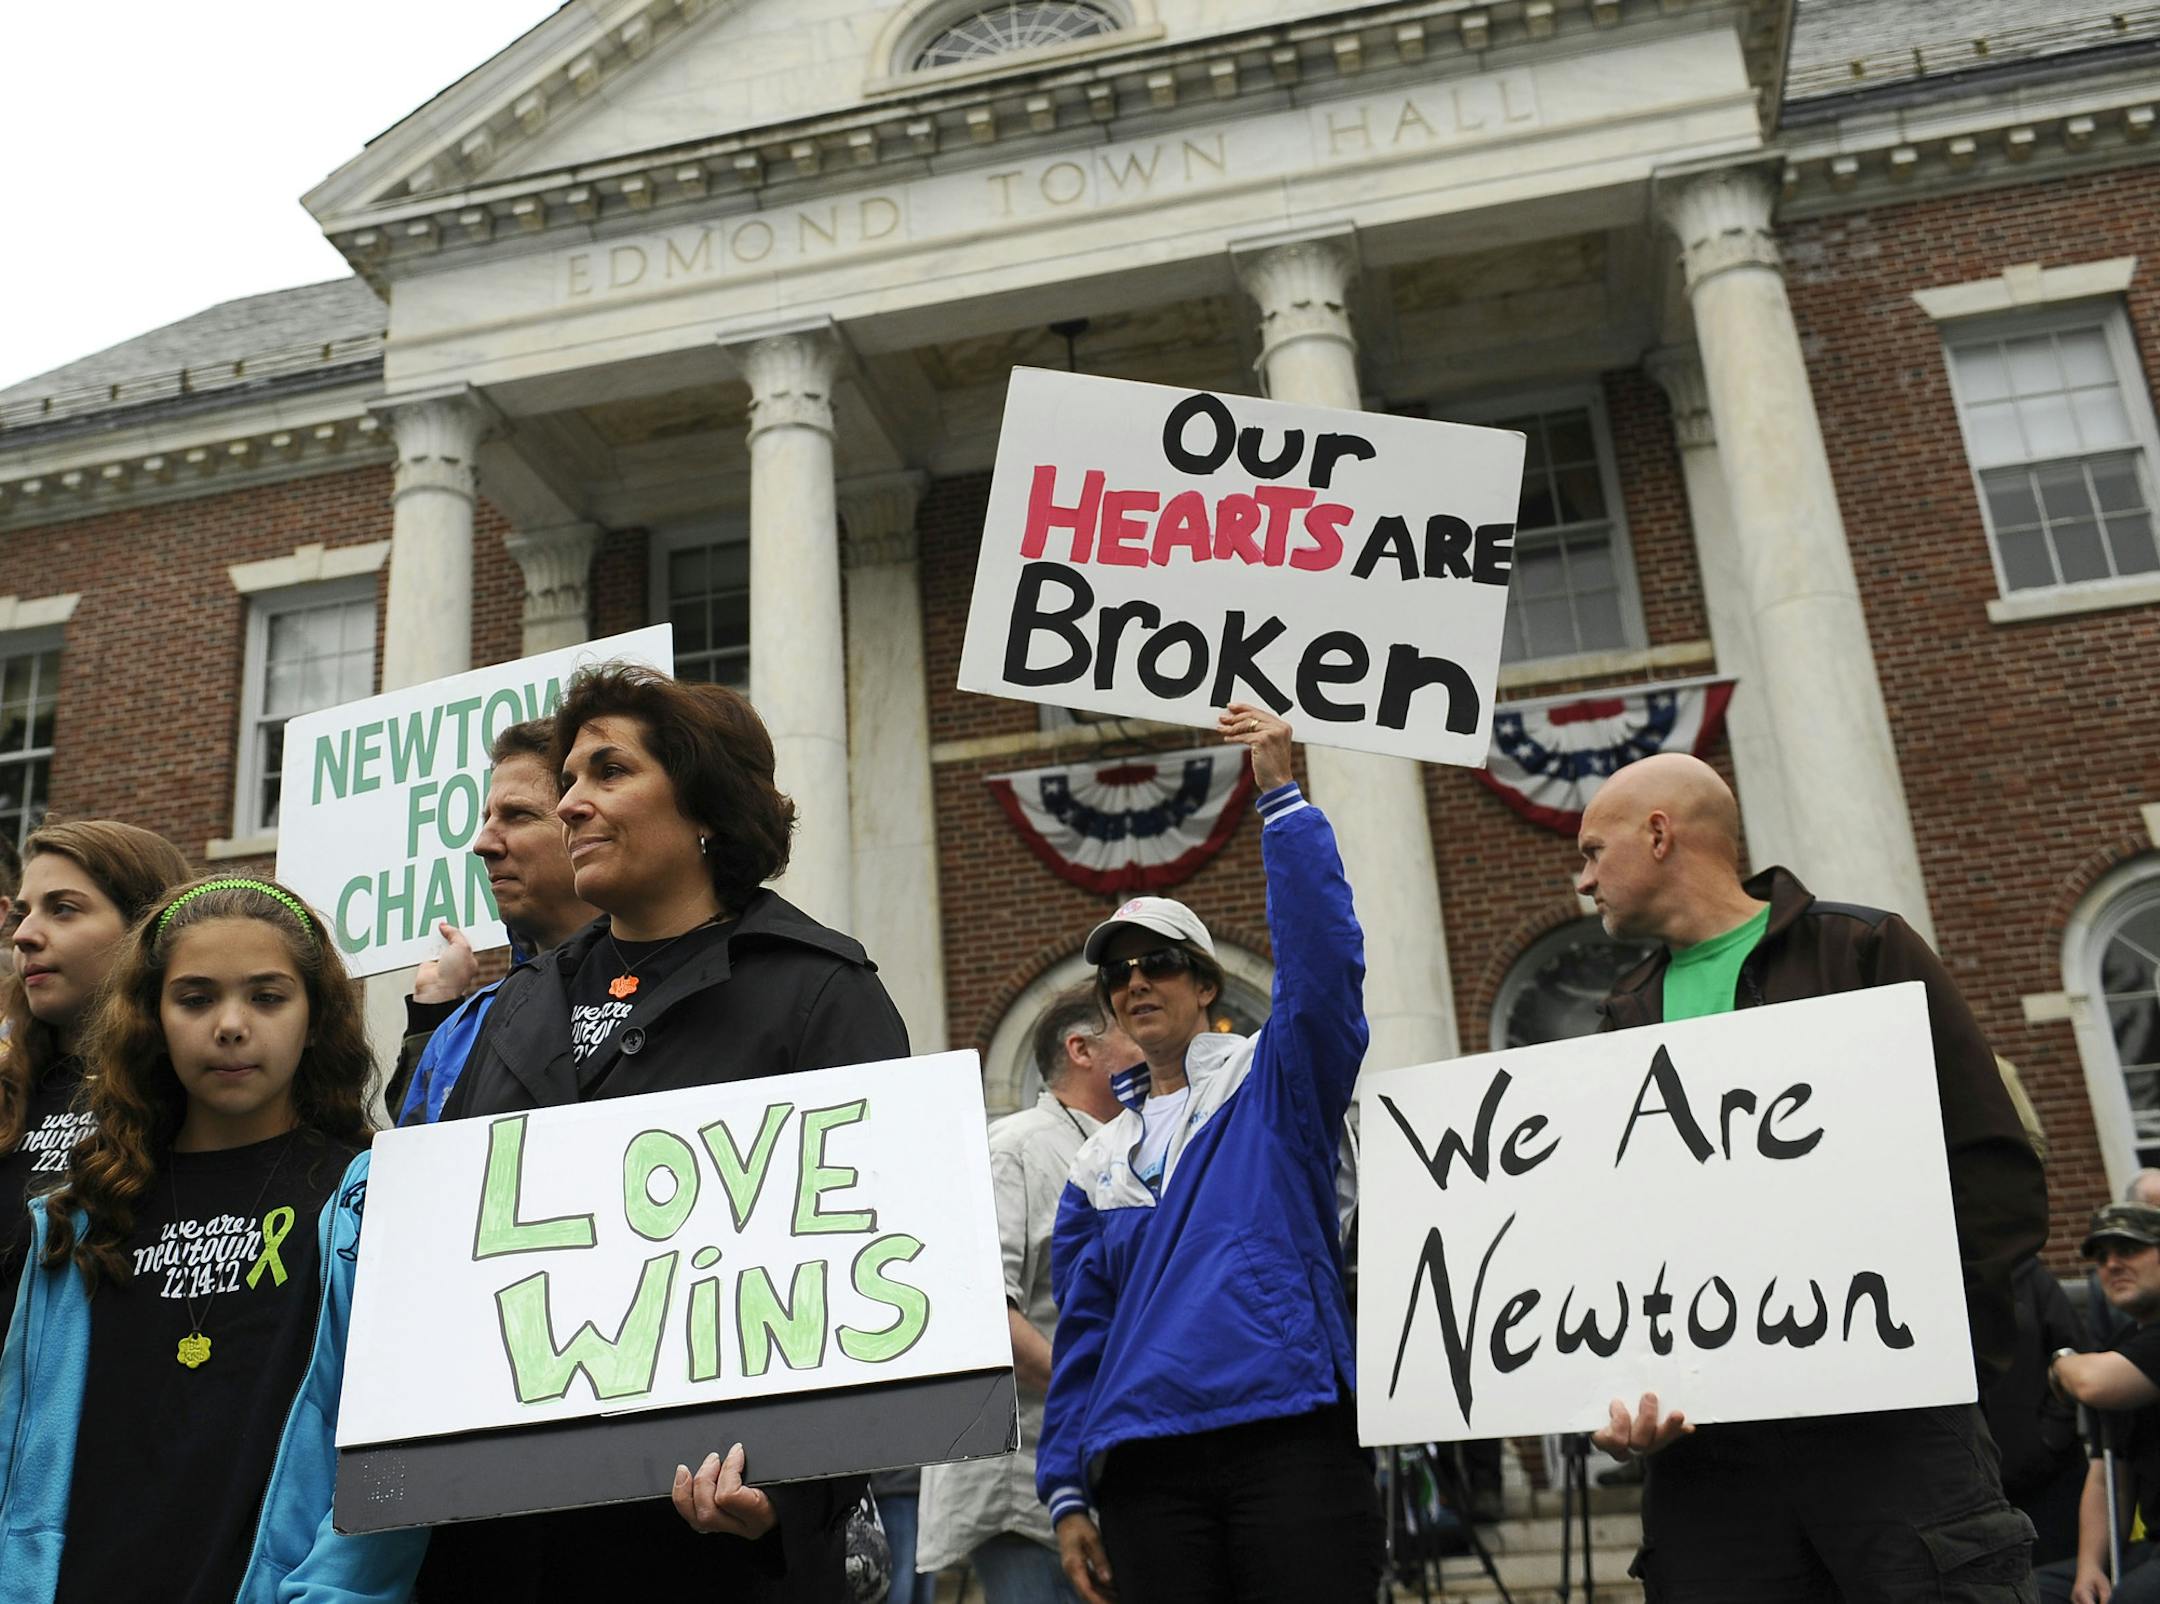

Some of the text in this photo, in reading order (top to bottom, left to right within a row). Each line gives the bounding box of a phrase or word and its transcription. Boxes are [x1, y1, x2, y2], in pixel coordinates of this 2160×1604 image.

[567, 79, 1534, 297] EDMOND TOWN HALL
[1162, 392, 1377, 488] Our
[1019, 464, 1517, 586] HEARTS ARE
[311, 676, 562, 806] NEWTO
[406, 770, 493, 860] FO
[335, 852, 499, 955] CHAN
[472, 1098, 877, 1261] LOVE
[1378, 1043, 1825, 1191] We Are
[160, 1213, 256, 1242] we are
[1388, 1211, 1915, 1430] Newtown
